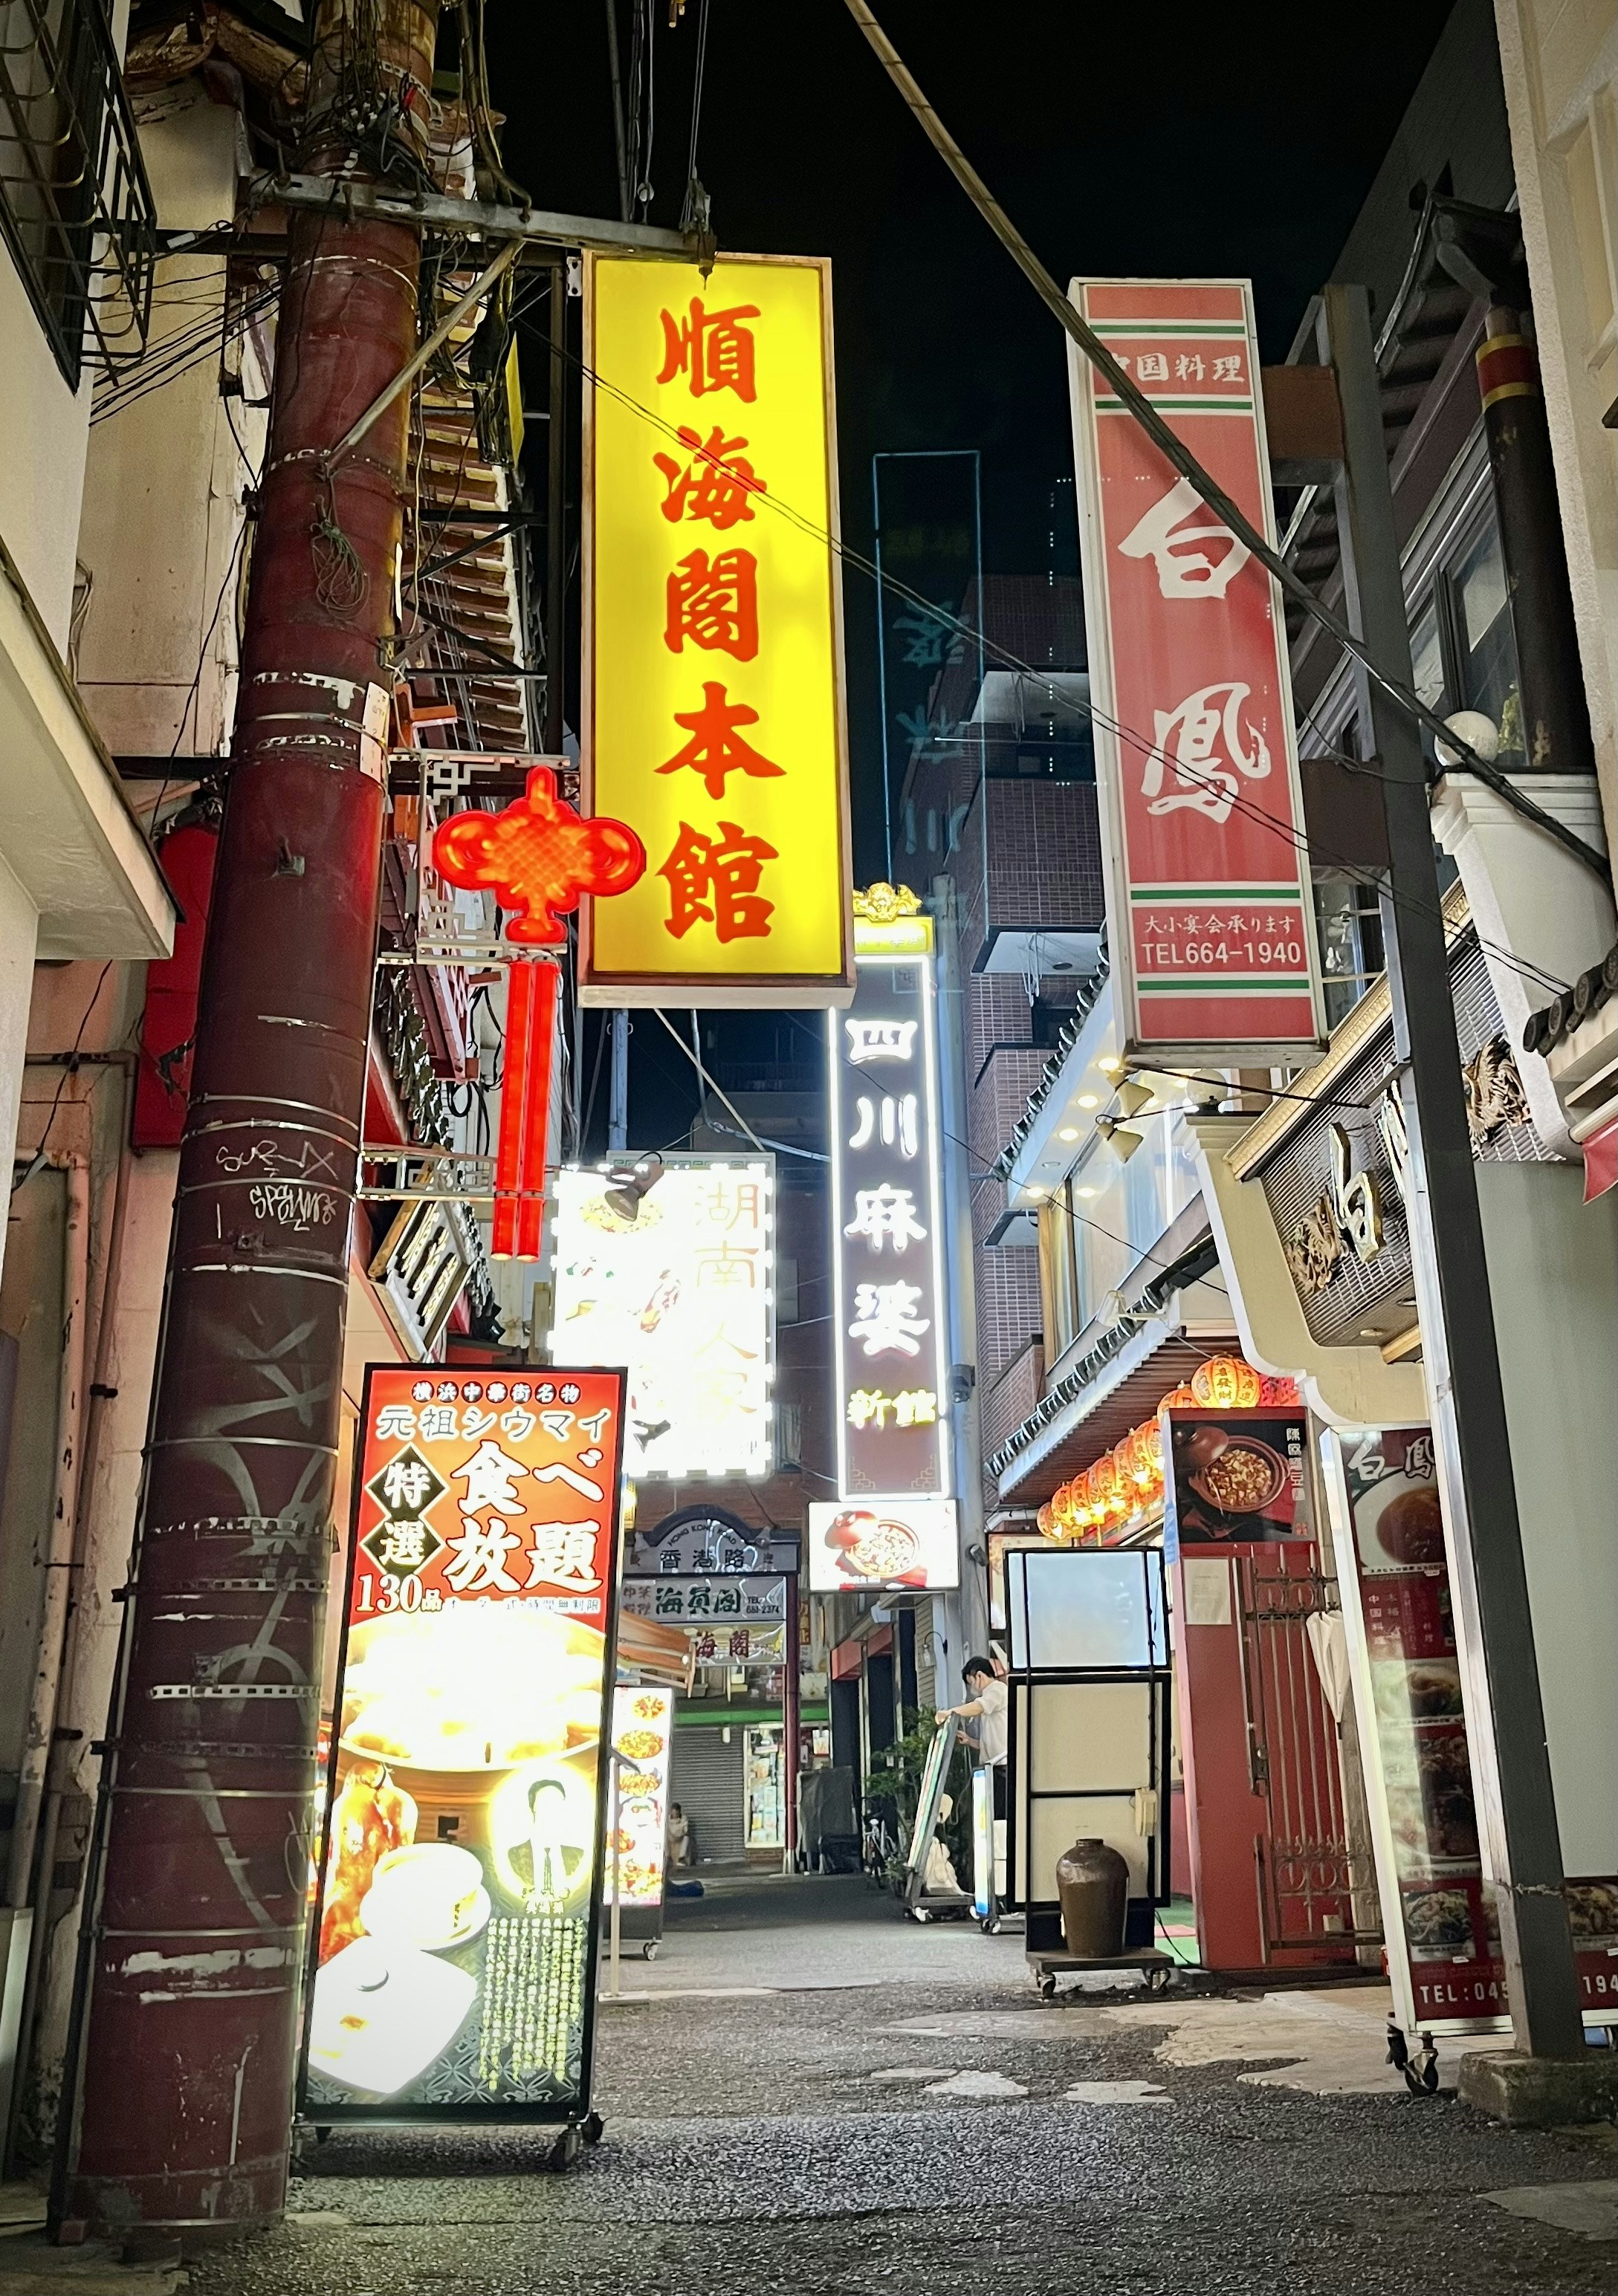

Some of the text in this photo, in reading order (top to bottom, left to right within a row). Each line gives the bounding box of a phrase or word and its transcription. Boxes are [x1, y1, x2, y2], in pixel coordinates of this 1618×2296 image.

[653, 296, 786, 944] 順海閣本館
[1145, 913, 1295, 935] 大小宴会承ります
[844, 1019, 931, 1358] 四川麻婆
[378, 1406, 610, 1441] 元祖シウマイ
[845, 1389, 936, 1428] 新館
[379, 1462, 430, 1566] 特選
[667, 1528, 689, 1546] HONG
[355, 1574, 444, 1612] 130品
[656, 1586, 741, 1615] 海員閣
